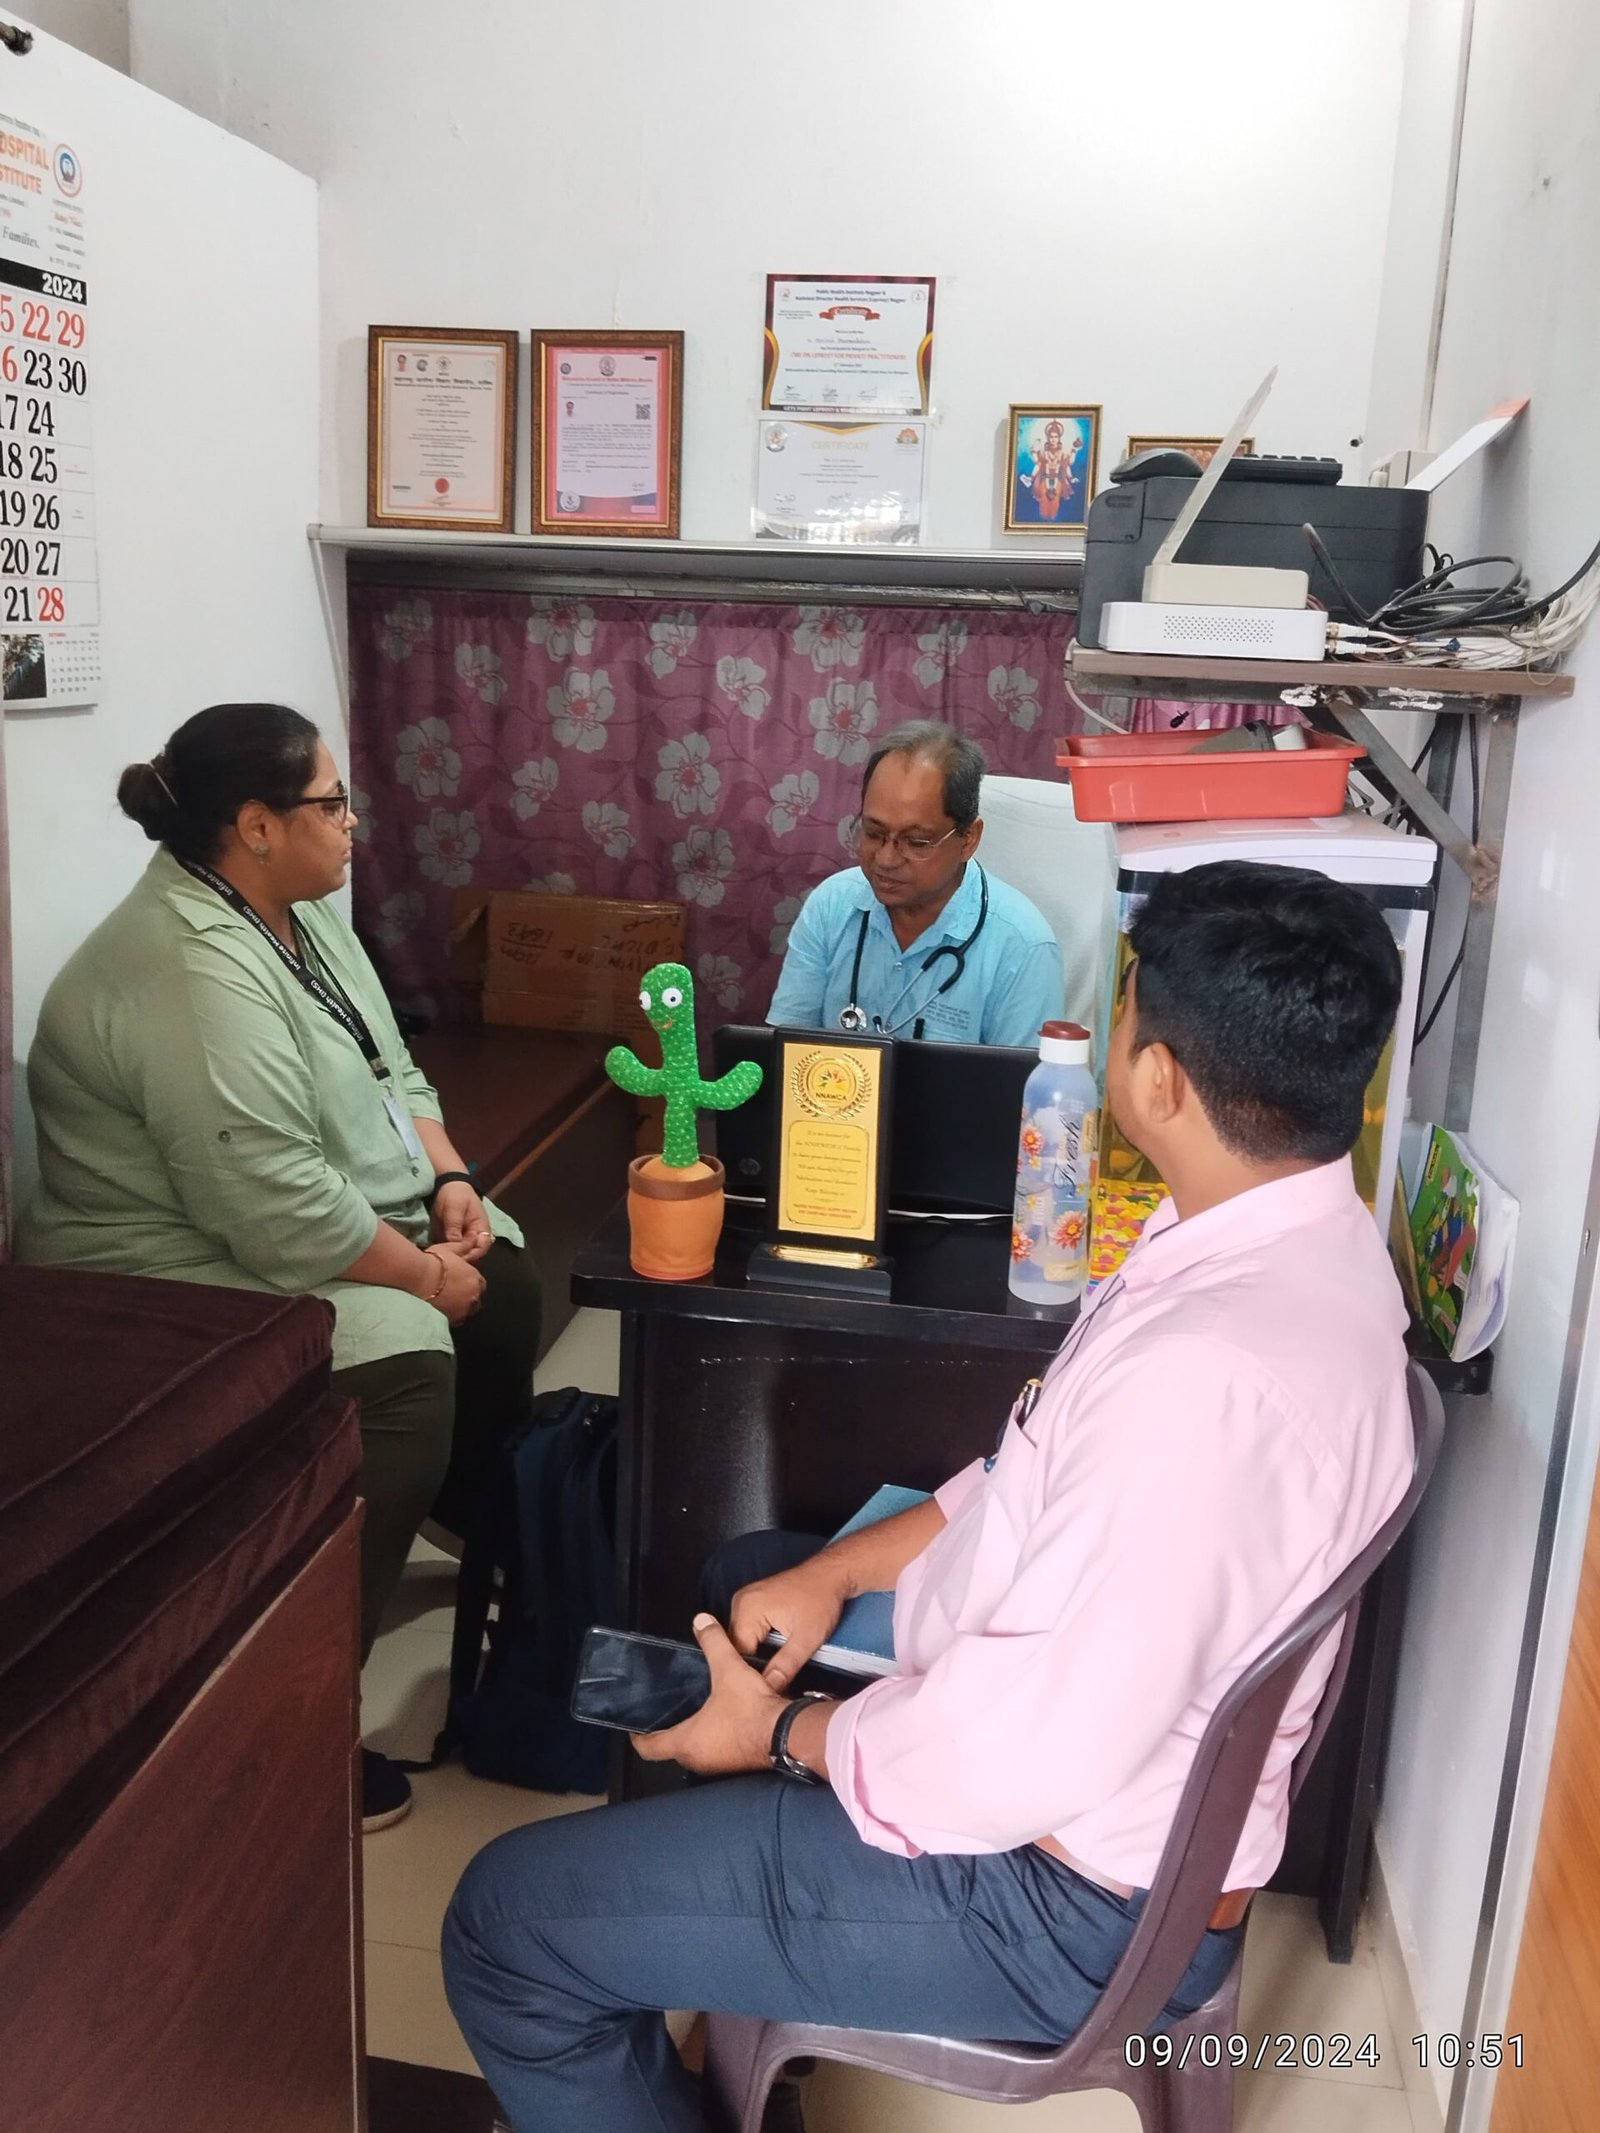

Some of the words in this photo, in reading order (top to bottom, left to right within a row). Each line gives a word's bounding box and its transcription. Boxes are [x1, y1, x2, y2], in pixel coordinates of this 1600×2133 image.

[42, 272, 83, 302] 2024
[21, 301, 51, 342] 22
[56, 310, 85, 349] 29
[0, 345, 18, 382] 6
[24, 349, 53, 389] 23
[58, 357, 87, 396] 30
[27, 398, 55, 437] 24
[29, 445, 58, 484] 25
[0, 489, 26, 527] 19
[32, 493, 60, 531] 26
[1, 538, 30, 575] 20
[35, 540, 61, 576] 27
[4, 586, 33, 622] 21
[37, 587, 65, 622] 28
[259, 922, 280, 947] Health
[278, 944, 301, 971] Infinite
[310, 979, 327, 998] (IHS)
[325, 996, 347, 1019] Health
[345, 1016, 364, 1041] Infinite
[1053, 1113, 1080, 1197] Fresh
